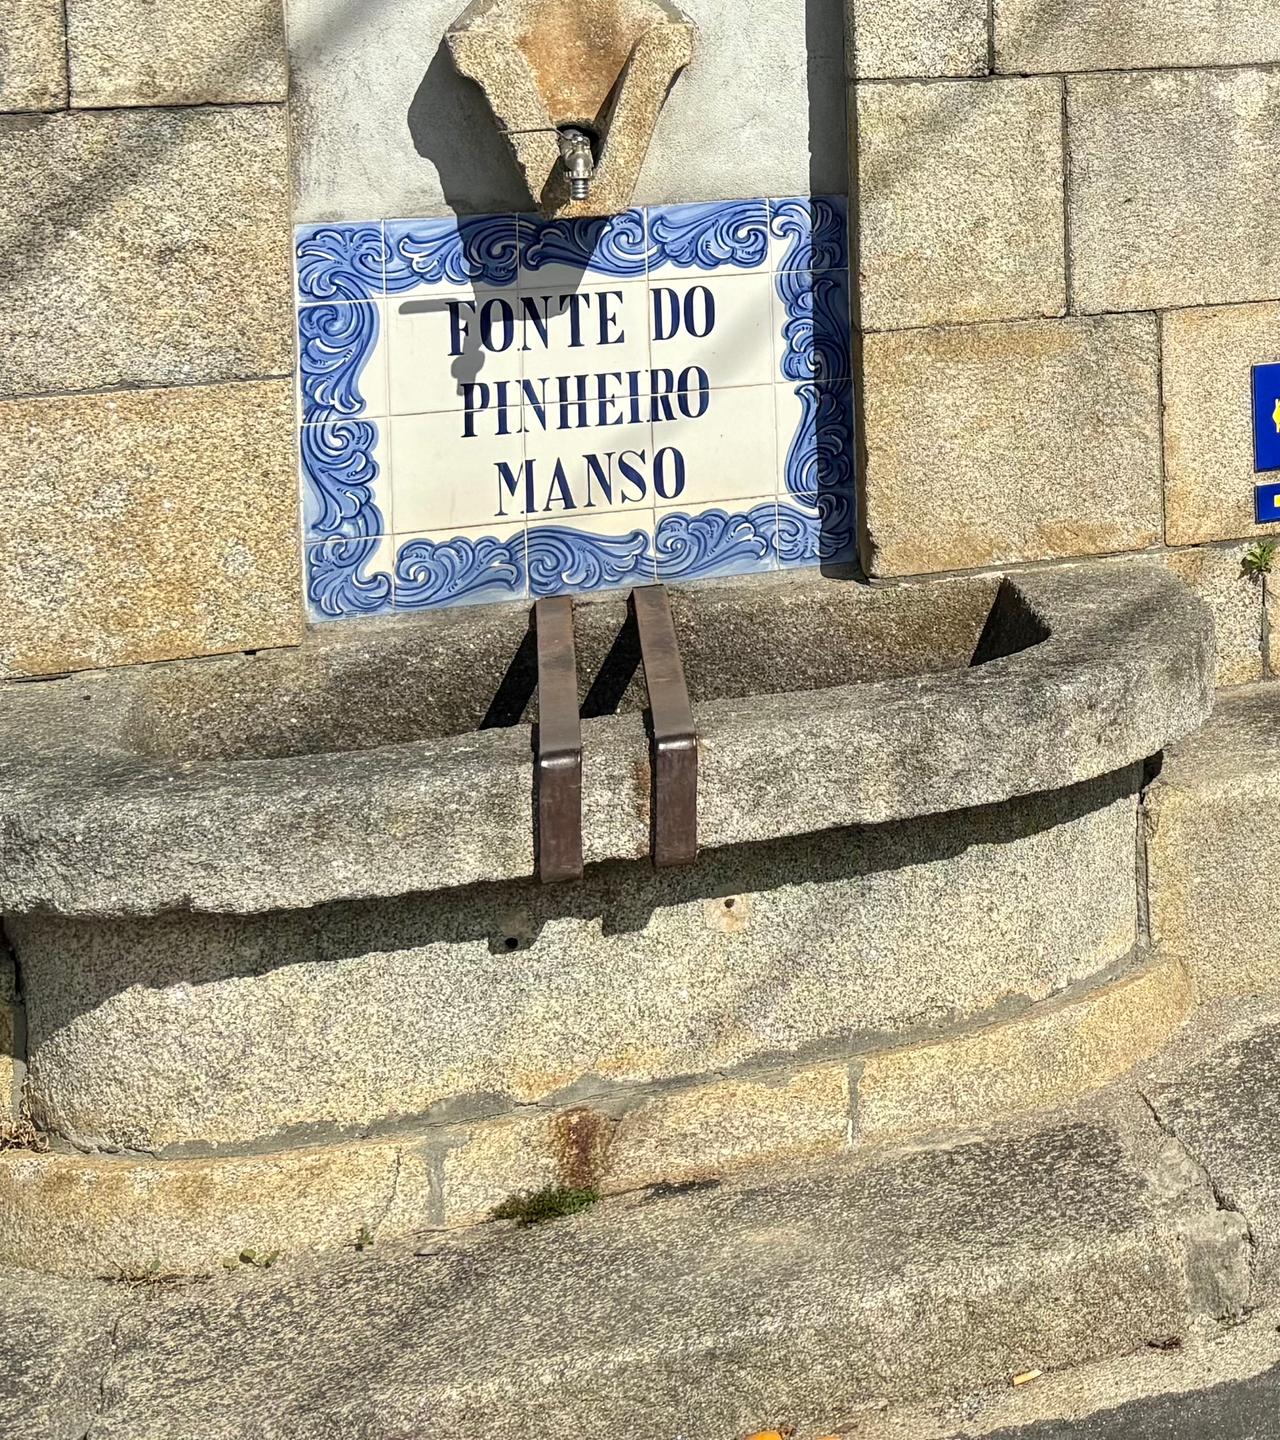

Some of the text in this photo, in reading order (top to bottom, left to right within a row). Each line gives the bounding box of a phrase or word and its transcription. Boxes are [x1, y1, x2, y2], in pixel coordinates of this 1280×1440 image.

[445, 285, 716, 357] FONTE DO
[460, 365, 710, 438] PINHEIRO
[493, 446, 686, 517] MANSO
